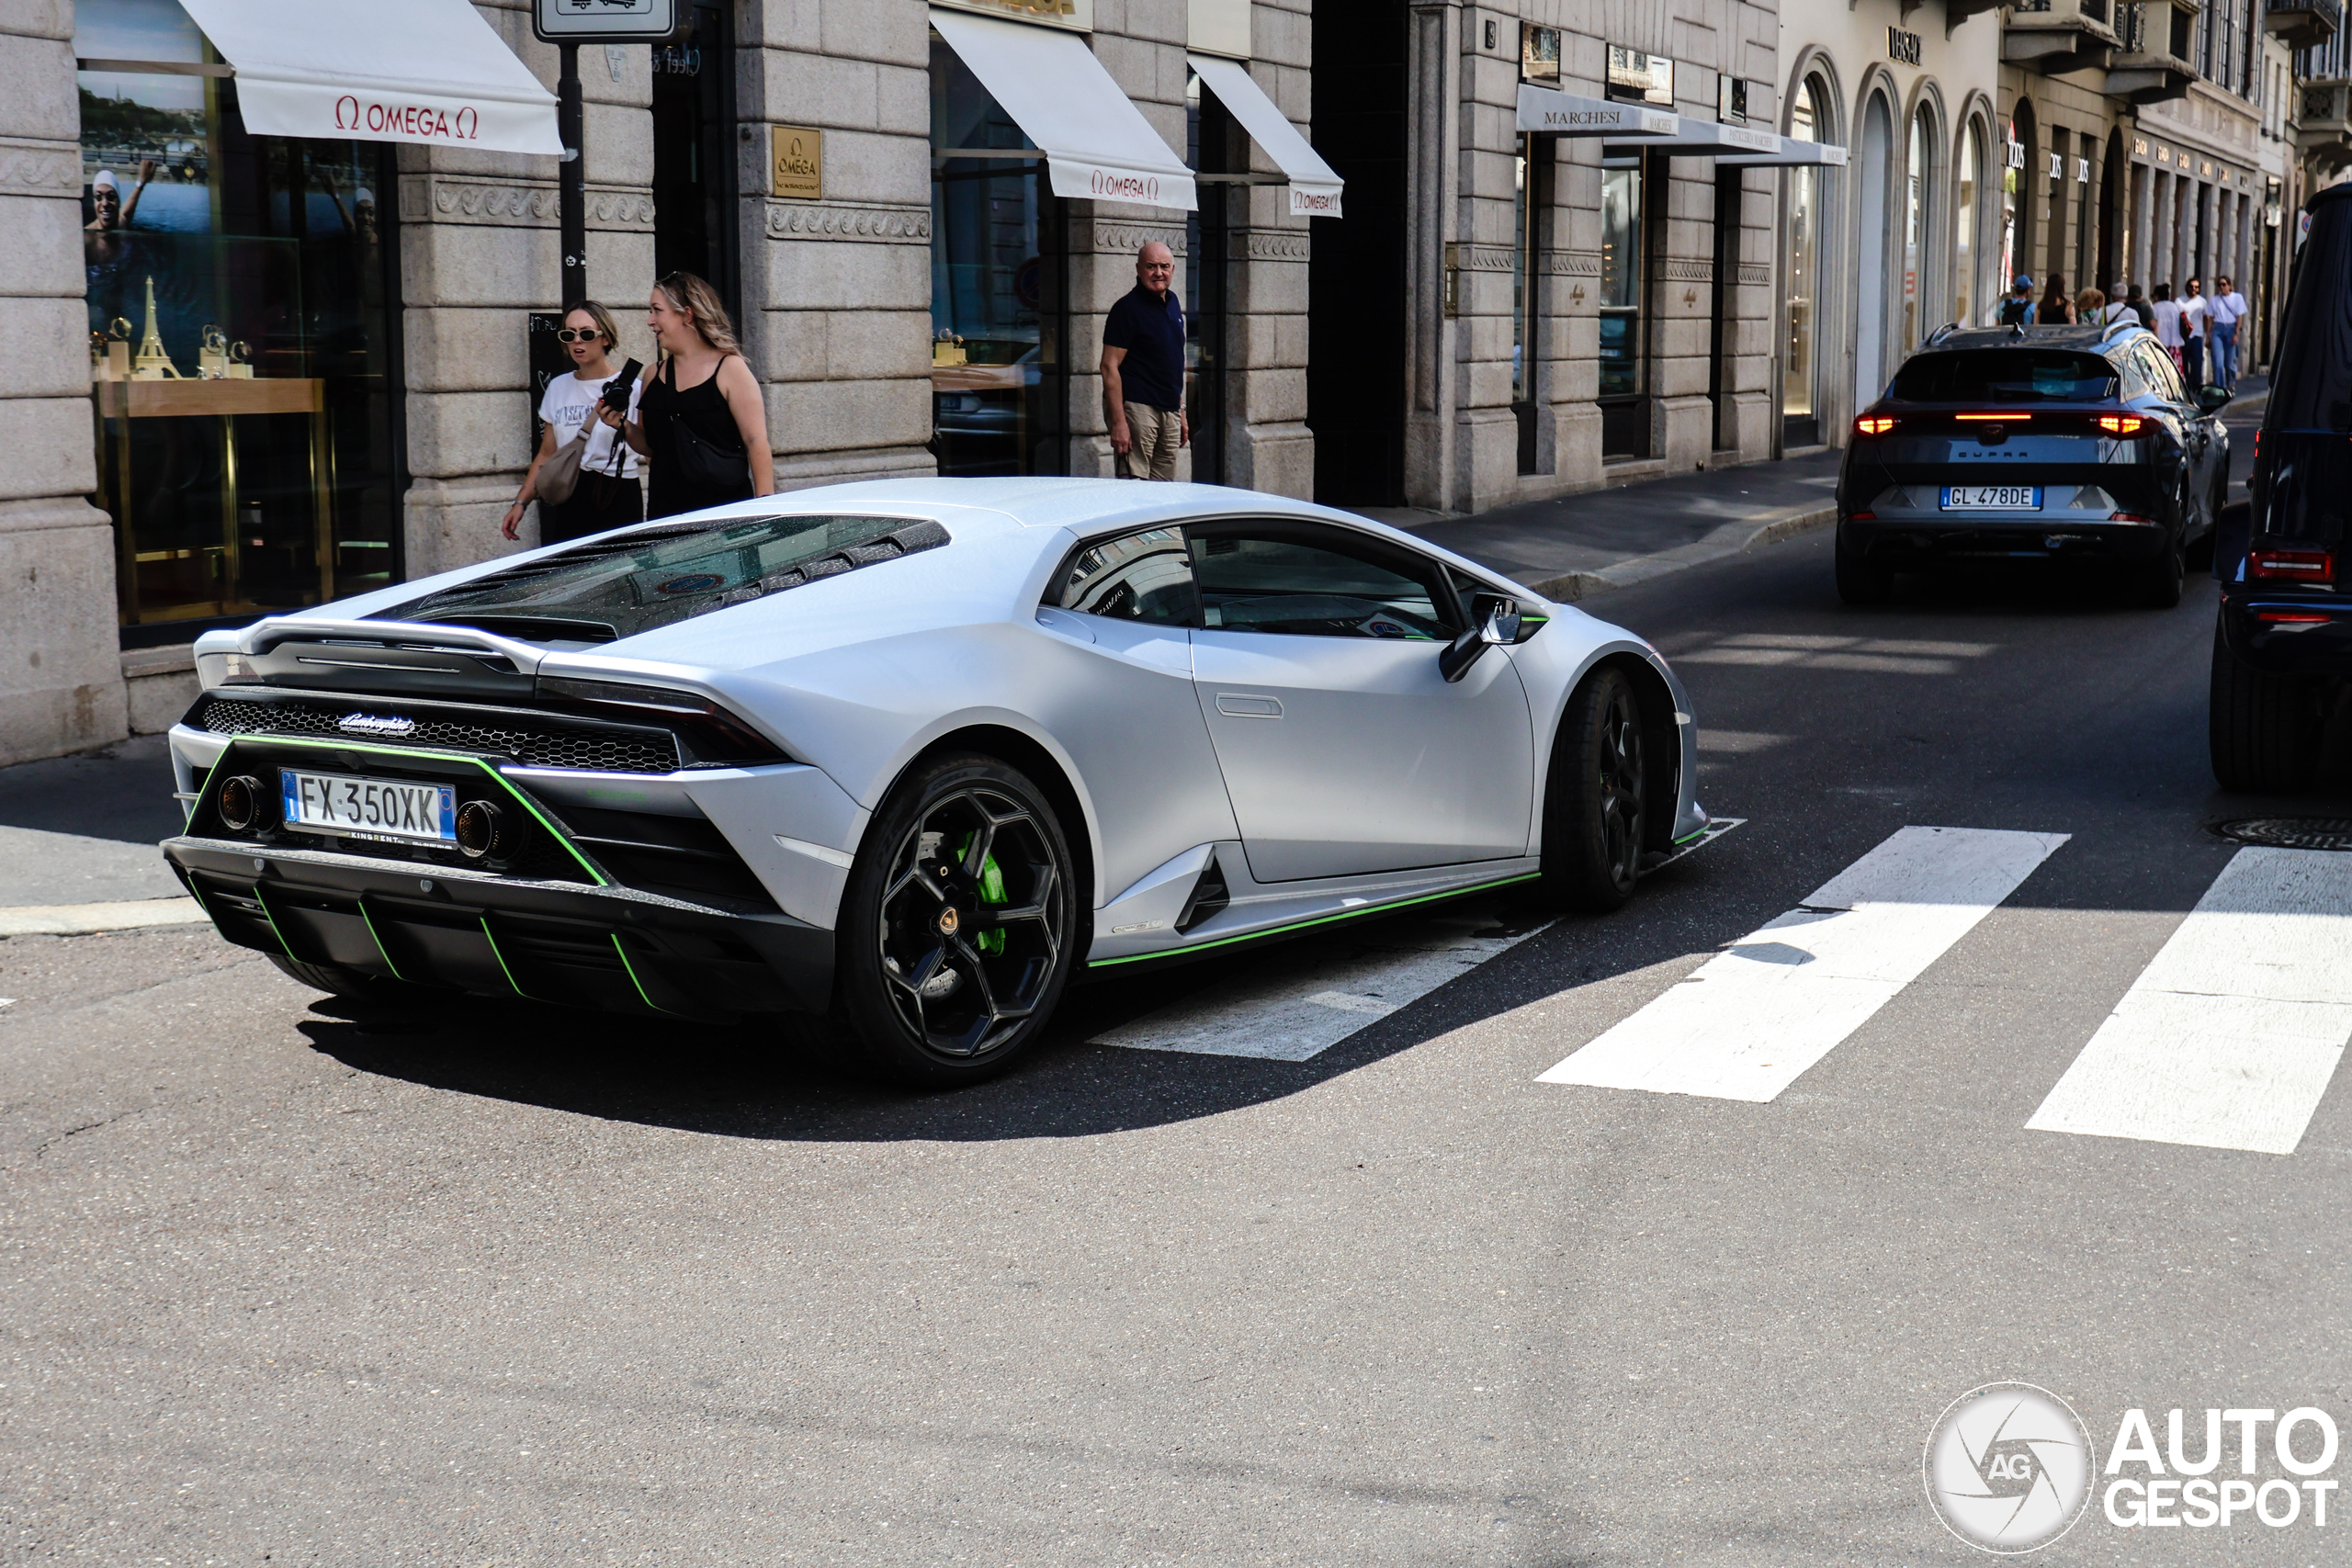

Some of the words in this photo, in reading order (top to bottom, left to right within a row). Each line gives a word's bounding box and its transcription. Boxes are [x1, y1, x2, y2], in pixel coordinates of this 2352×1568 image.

[368, 104, 449, 138] OMEGA
[1544, 111, 1621, 125] MARCHESI
[1649, 117, 1672, 130] MARCHESI
[778, 158, 816, 175] OMEGA
[1106, 176, 1144, 198] OMEGA
[1304, 195, 1329, 209] OMEGA
[1951, 488, 1971, 504] GL
[1978, 488, 2030, 504] 478DE
[339, 713, 414, 732] Lamborghini
[300, 777, 336, 821] FX
[345, 783, 436, 832] 350XK
[351, 831, 399, 843] KINGRENT
